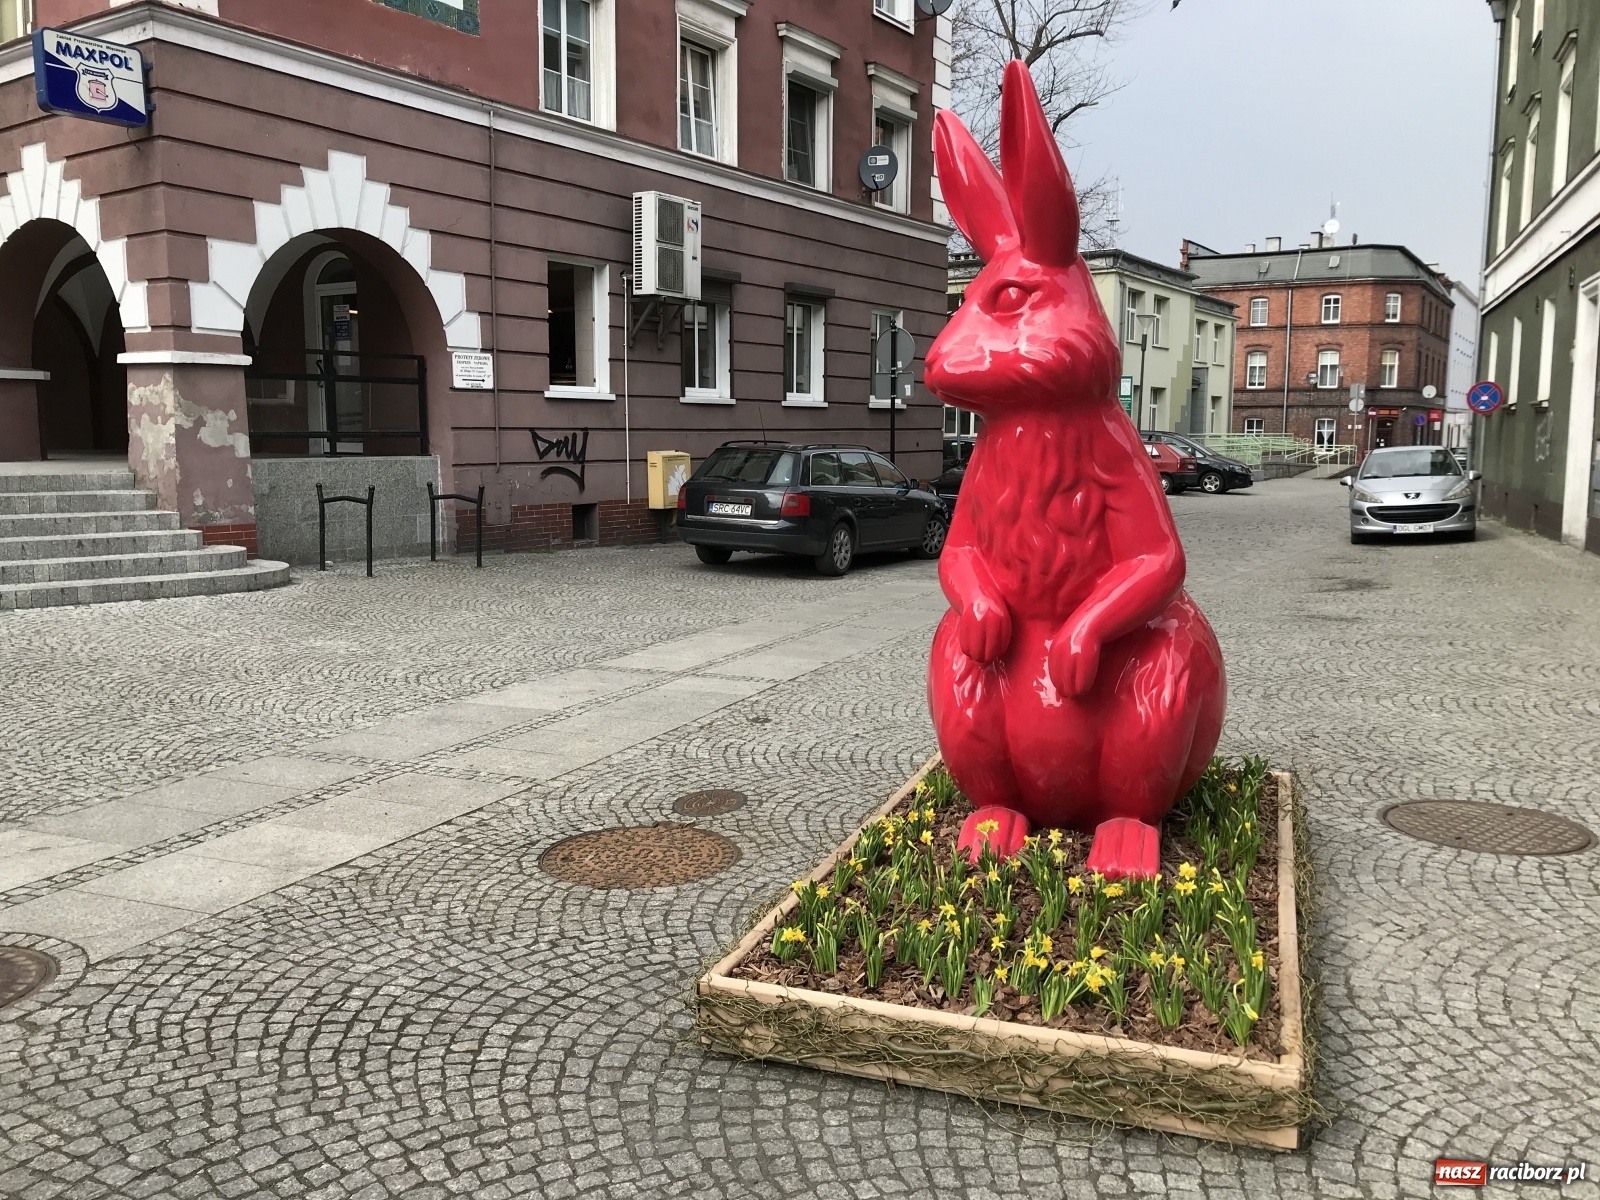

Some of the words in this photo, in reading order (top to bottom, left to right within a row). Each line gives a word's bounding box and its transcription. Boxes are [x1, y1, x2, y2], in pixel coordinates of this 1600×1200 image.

[55, 40, 134, 72] MAXPOL
[713, 503, 730, 513] SRC
[731, 504, 751, 515] 64VC
